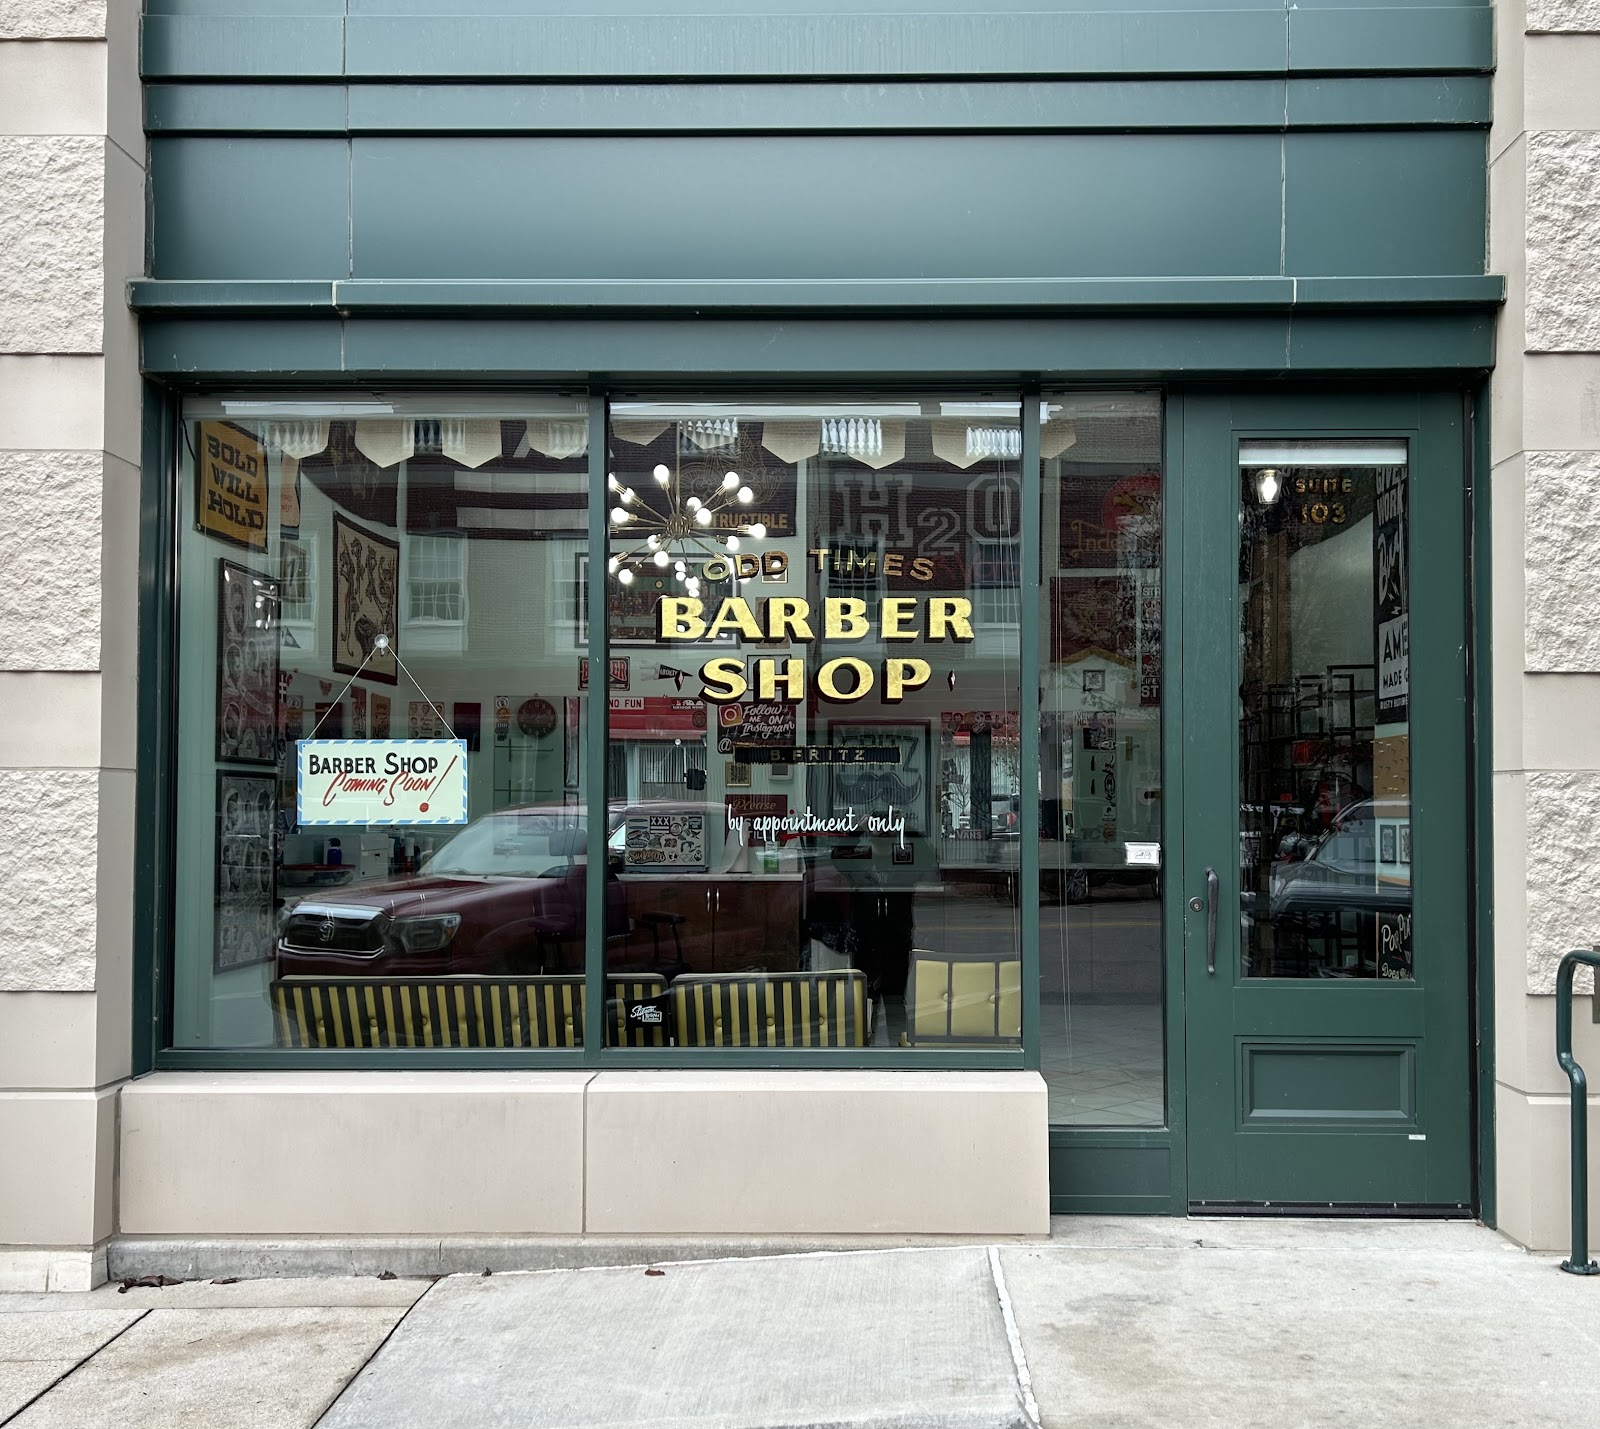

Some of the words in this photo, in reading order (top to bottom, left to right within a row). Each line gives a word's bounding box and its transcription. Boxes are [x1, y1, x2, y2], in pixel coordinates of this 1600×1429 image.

[206, 433, 258, 478] BOLD
[211, 463, 260, 505] WILL
[1295, 478, 1352, 494] SUITE
[207, 489, 265, 531] HOLD
[1301, 502, 1346, 524] 103
[702, 550, 788, 582] ODD
[808, 549, 935, 581] TIMES
[657, 597, 974, 643] BARBER
[698, 656, 931, 704] SHOP
[1383, 670, 1402, 689] MADE
[609, 699, 620, 708] NO
[625, 699, 642, 708] FUN
[743, 704, 783, 719] Follow
[740, 721, 796, 740] Instagram
[749, 715, 763, 723] ME
[768, 715, 785, 725] ON
[309, 755, 377, 774] BARBER
[384, 752, 439, 775] SHOP
[770, 749, 786, 761] B.
[793, 749, 865, 761] FRITZ
[733, 798, 777, 812] Please
[727, 803, 744, 847] by
[753, 805, 859, 843] appointment
[867, 804, 906, 851] only
